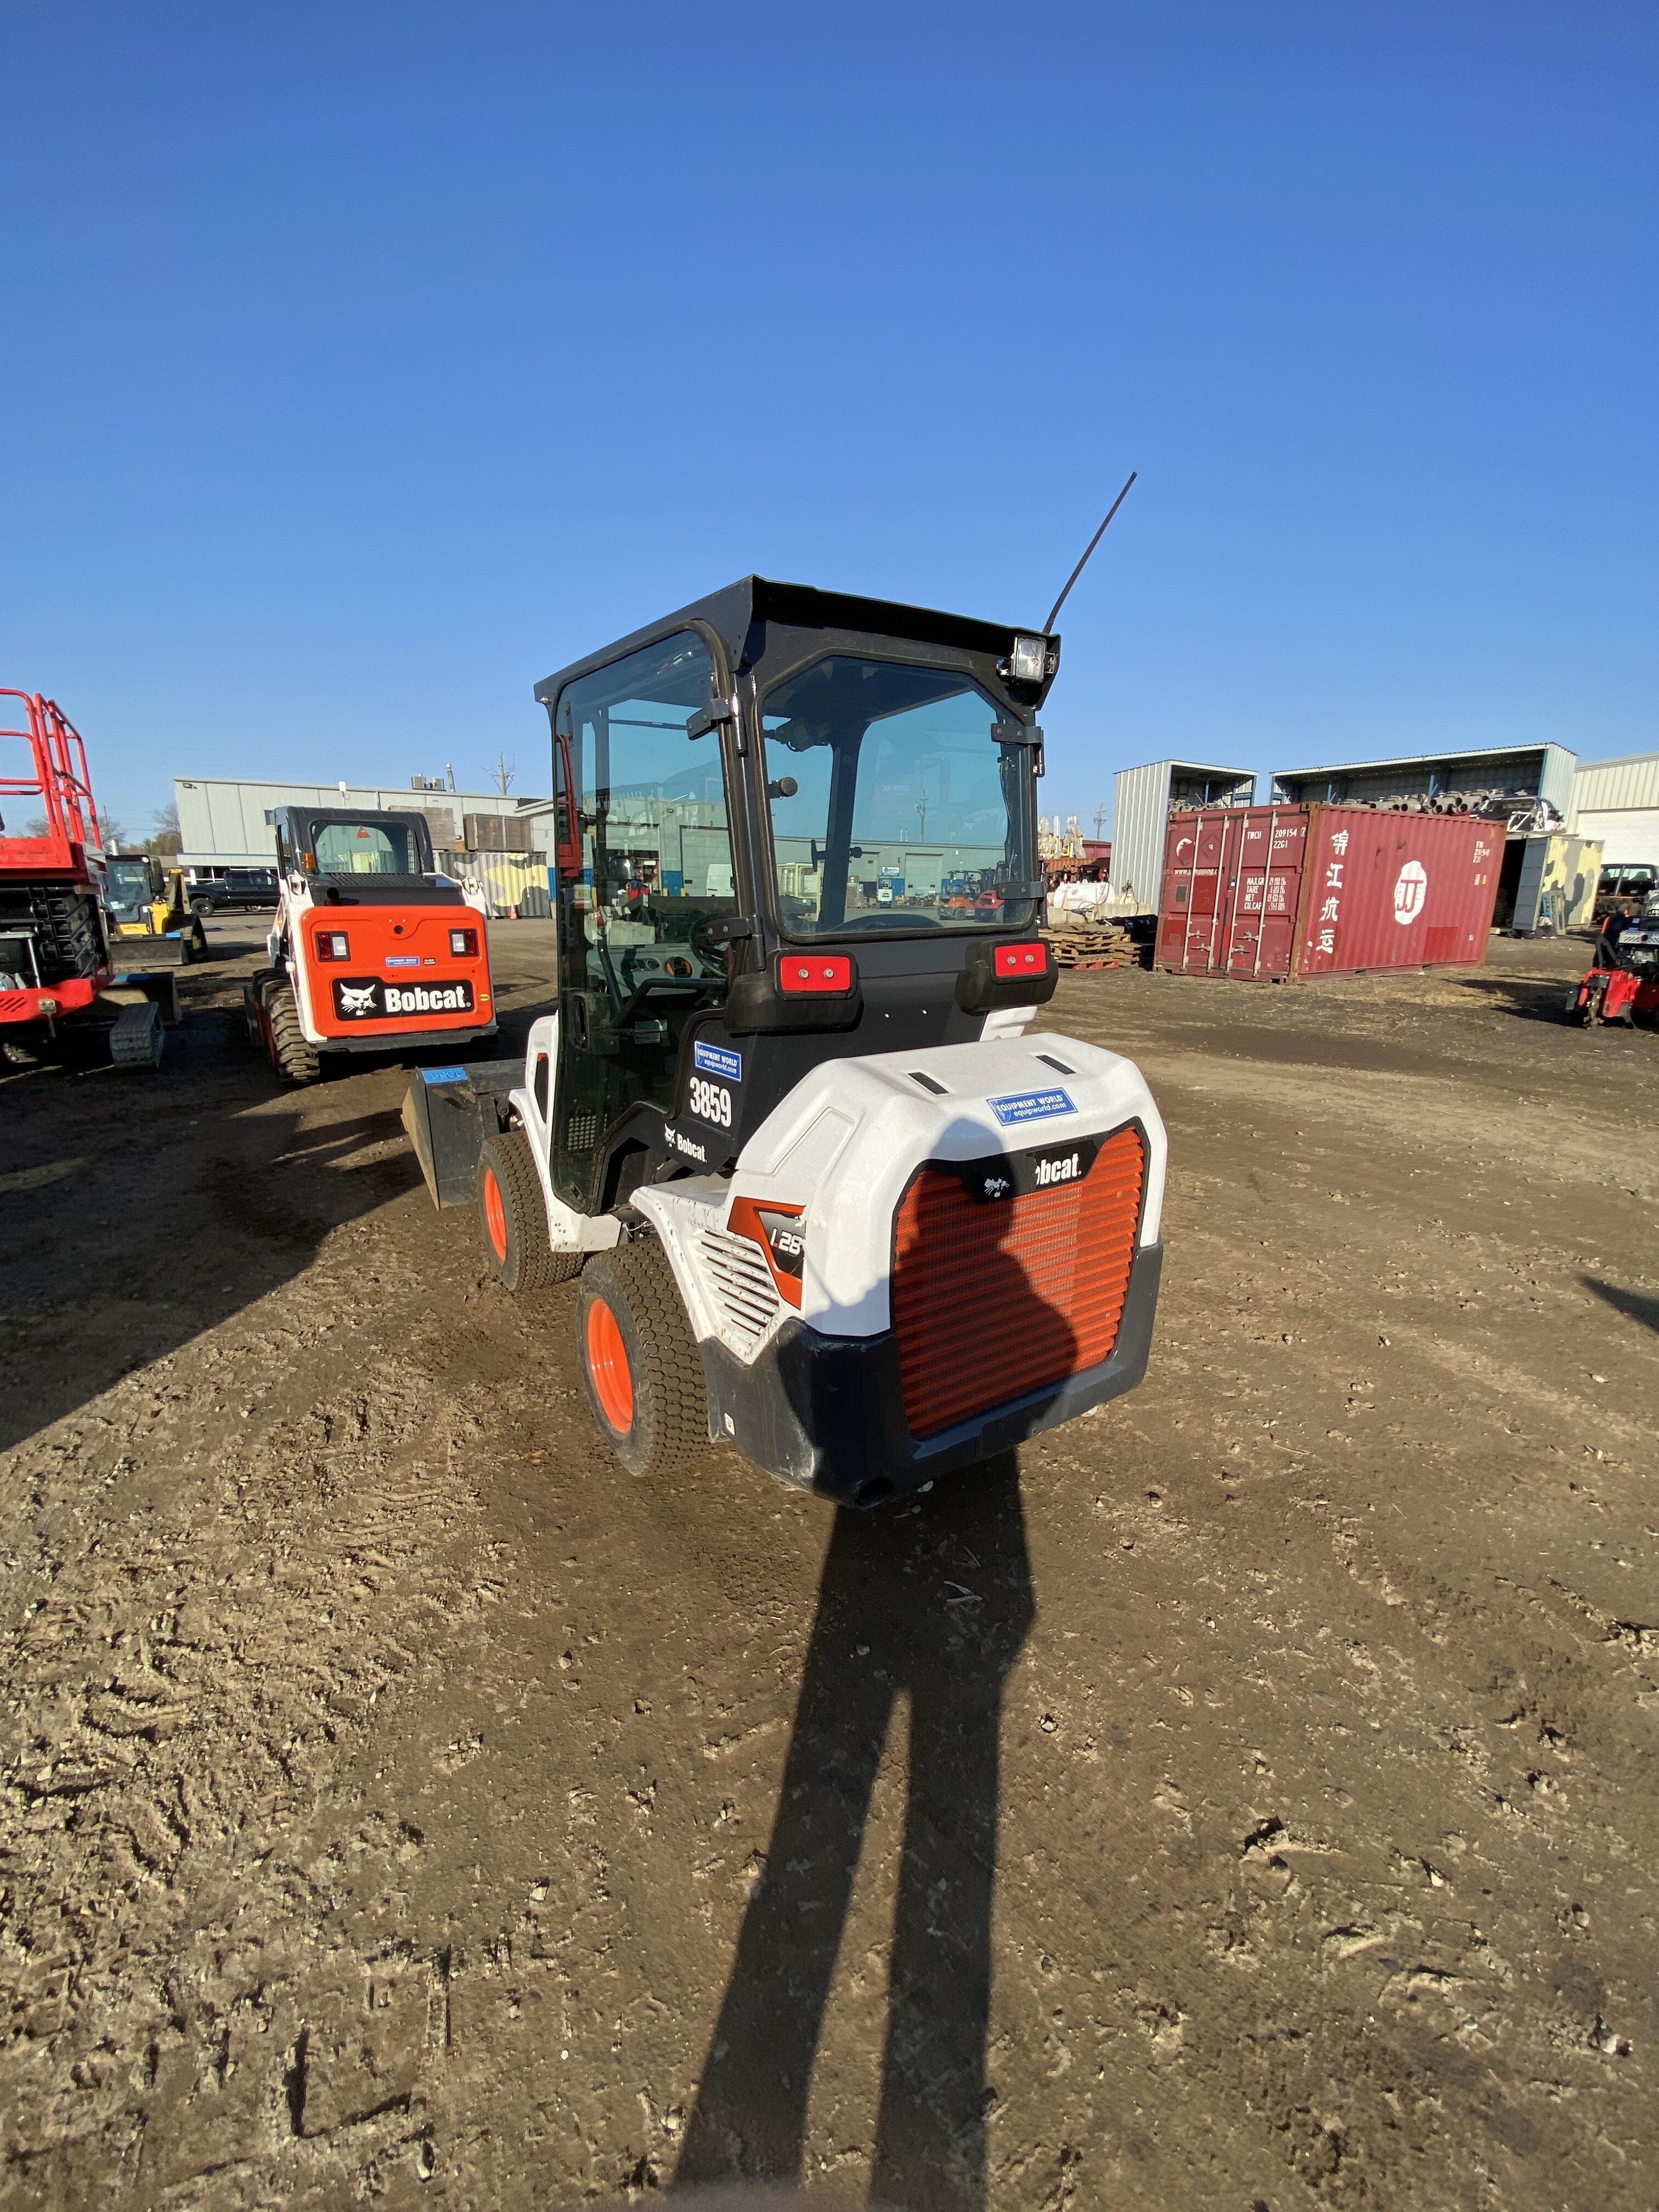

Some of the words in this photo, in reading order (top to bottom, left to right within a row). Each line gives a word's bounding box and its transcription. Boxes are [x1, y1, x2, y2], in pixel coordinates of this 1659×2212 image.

[1247, 831, 1262, 839] TWCU
[1274, 828, 1297, 838] 209154
[1301, 827, 1306, 837] 7
[1273, 840, 1288, 849] 22G1
[1246, 885, 1259, 894] TARE
[385, 985, 465, 1013] Bobcat
[697, 1048, 720, 1062] EQUIPMENT
[721, 1055, 737, 1067] WORLD
[704, 1059, 737, 1074] equipworld.com
[690, 1076, 732, 1127] 3859
[996, 1099, 1037, 1112] EQUIPMENT
[1037, 1094, 1063, 1104] WORLD
[1013, 1103, 1066, 1117] equipworld.com
[677, 1133, 706, 1163] Bobcat
